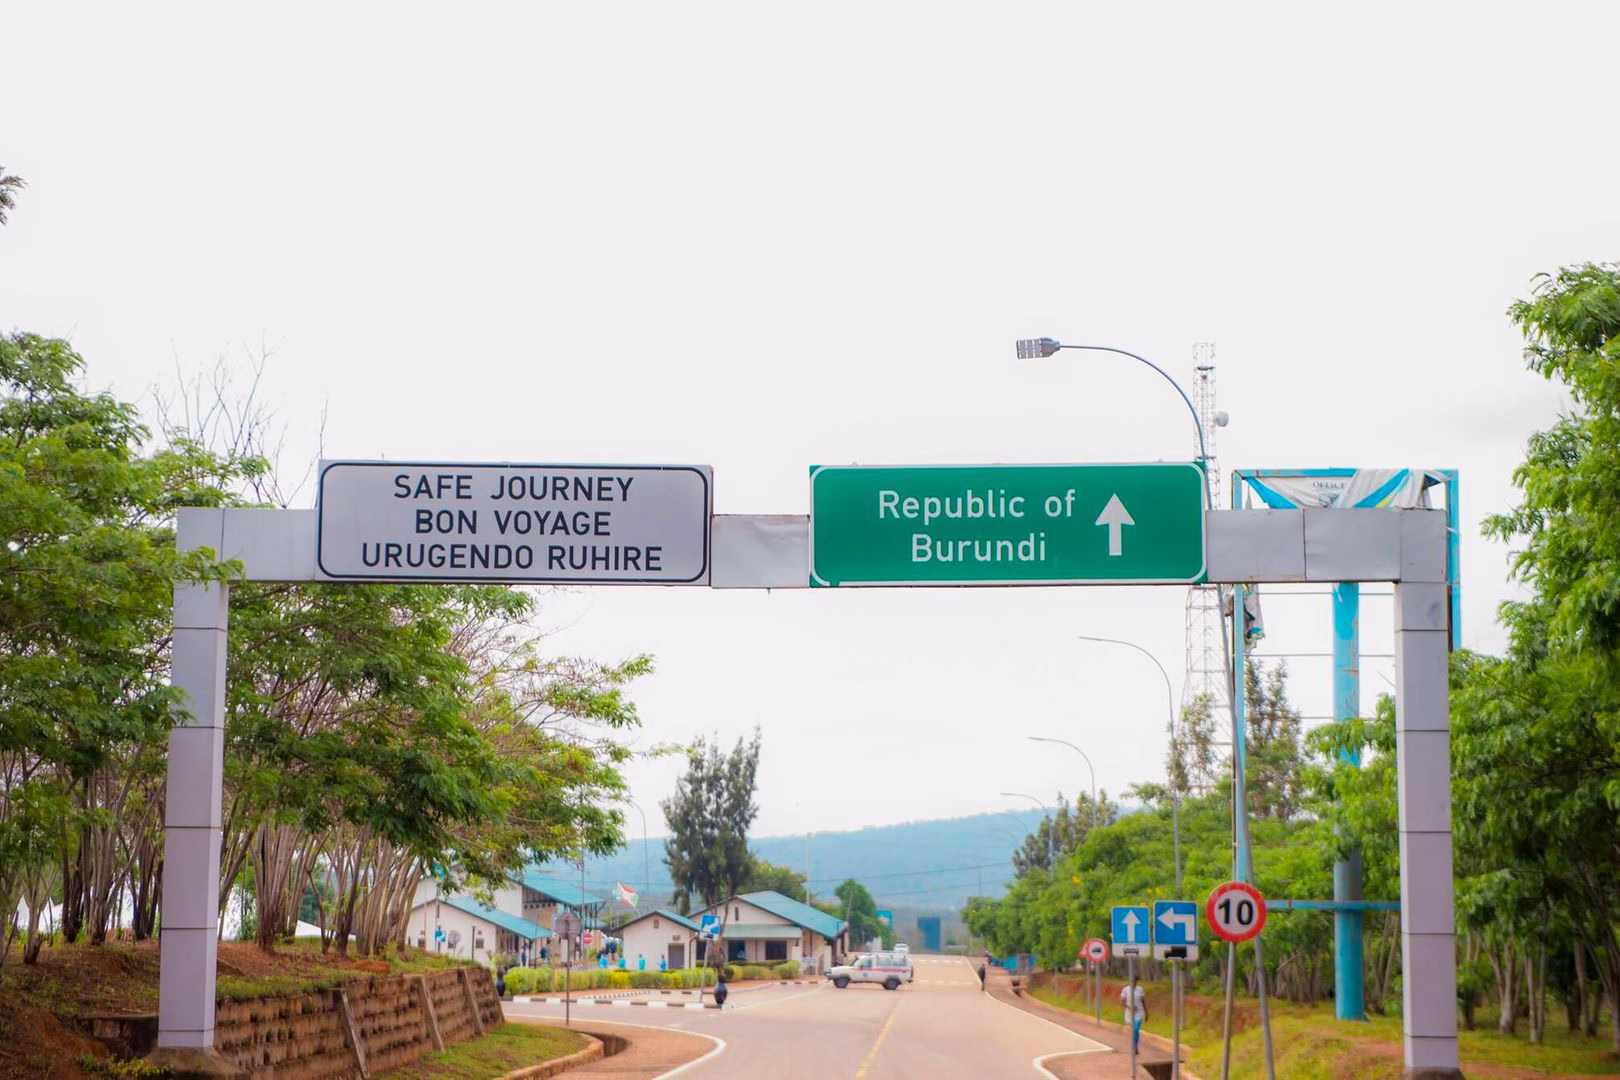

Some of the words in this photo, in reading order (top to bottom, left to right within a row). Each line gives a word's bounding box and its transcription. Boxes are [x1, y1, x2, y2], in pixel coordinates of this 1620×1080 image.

[393, 474, 474, 500] SAFE
[490, 475, 635, 502] JOURNEY
[879, 489, 1026, 525] Republic
[1044, 488, 1077, 518] of
[415, 508, 478, 535] BON
[493, 510, 612, 537] VOYAGE
[362, 542, 534, 570] URUGENDO
[548, 545, 663, 572] RUHIRE
[911, 532, 1046, 562] Burundi
[1217, 897, 1254, 926] 10
